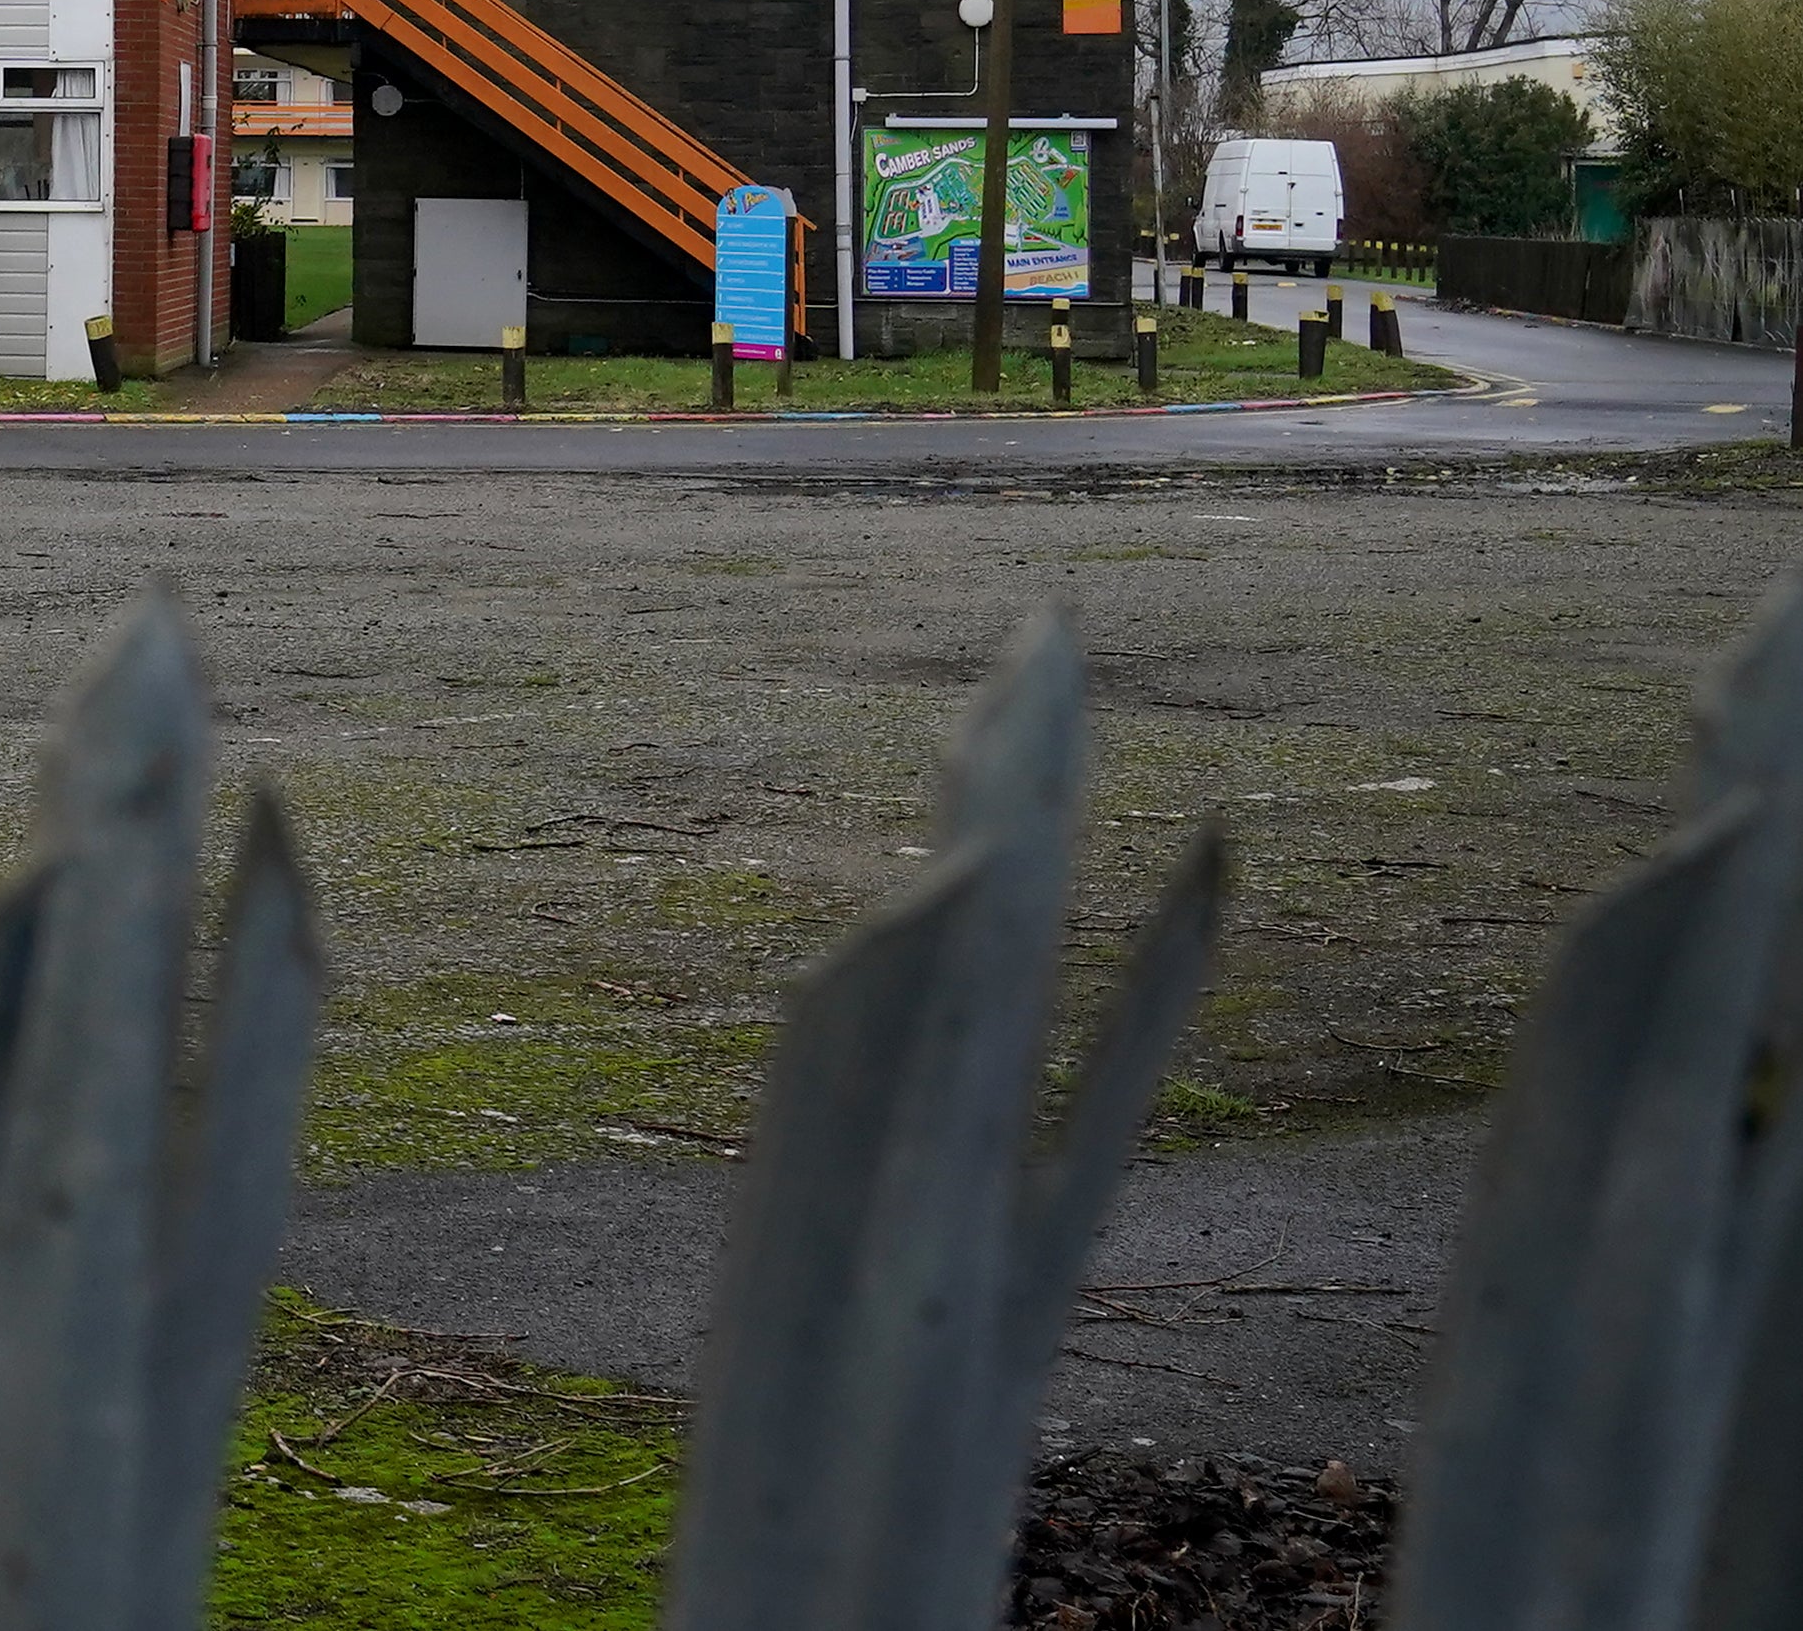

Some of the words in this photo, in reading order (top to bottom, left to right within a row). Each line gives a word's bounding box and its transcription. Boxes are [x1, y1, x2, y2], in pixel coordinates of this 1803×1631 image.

[875, 152, 931, 178] CAMBER
[932, 136, 976, 160] SANDS
[1007, 257, 1031, 268] MAIN
[1032, 253, 1078, 266] ENTRANCE
[1029, 272, 1072, 286] BEACH
